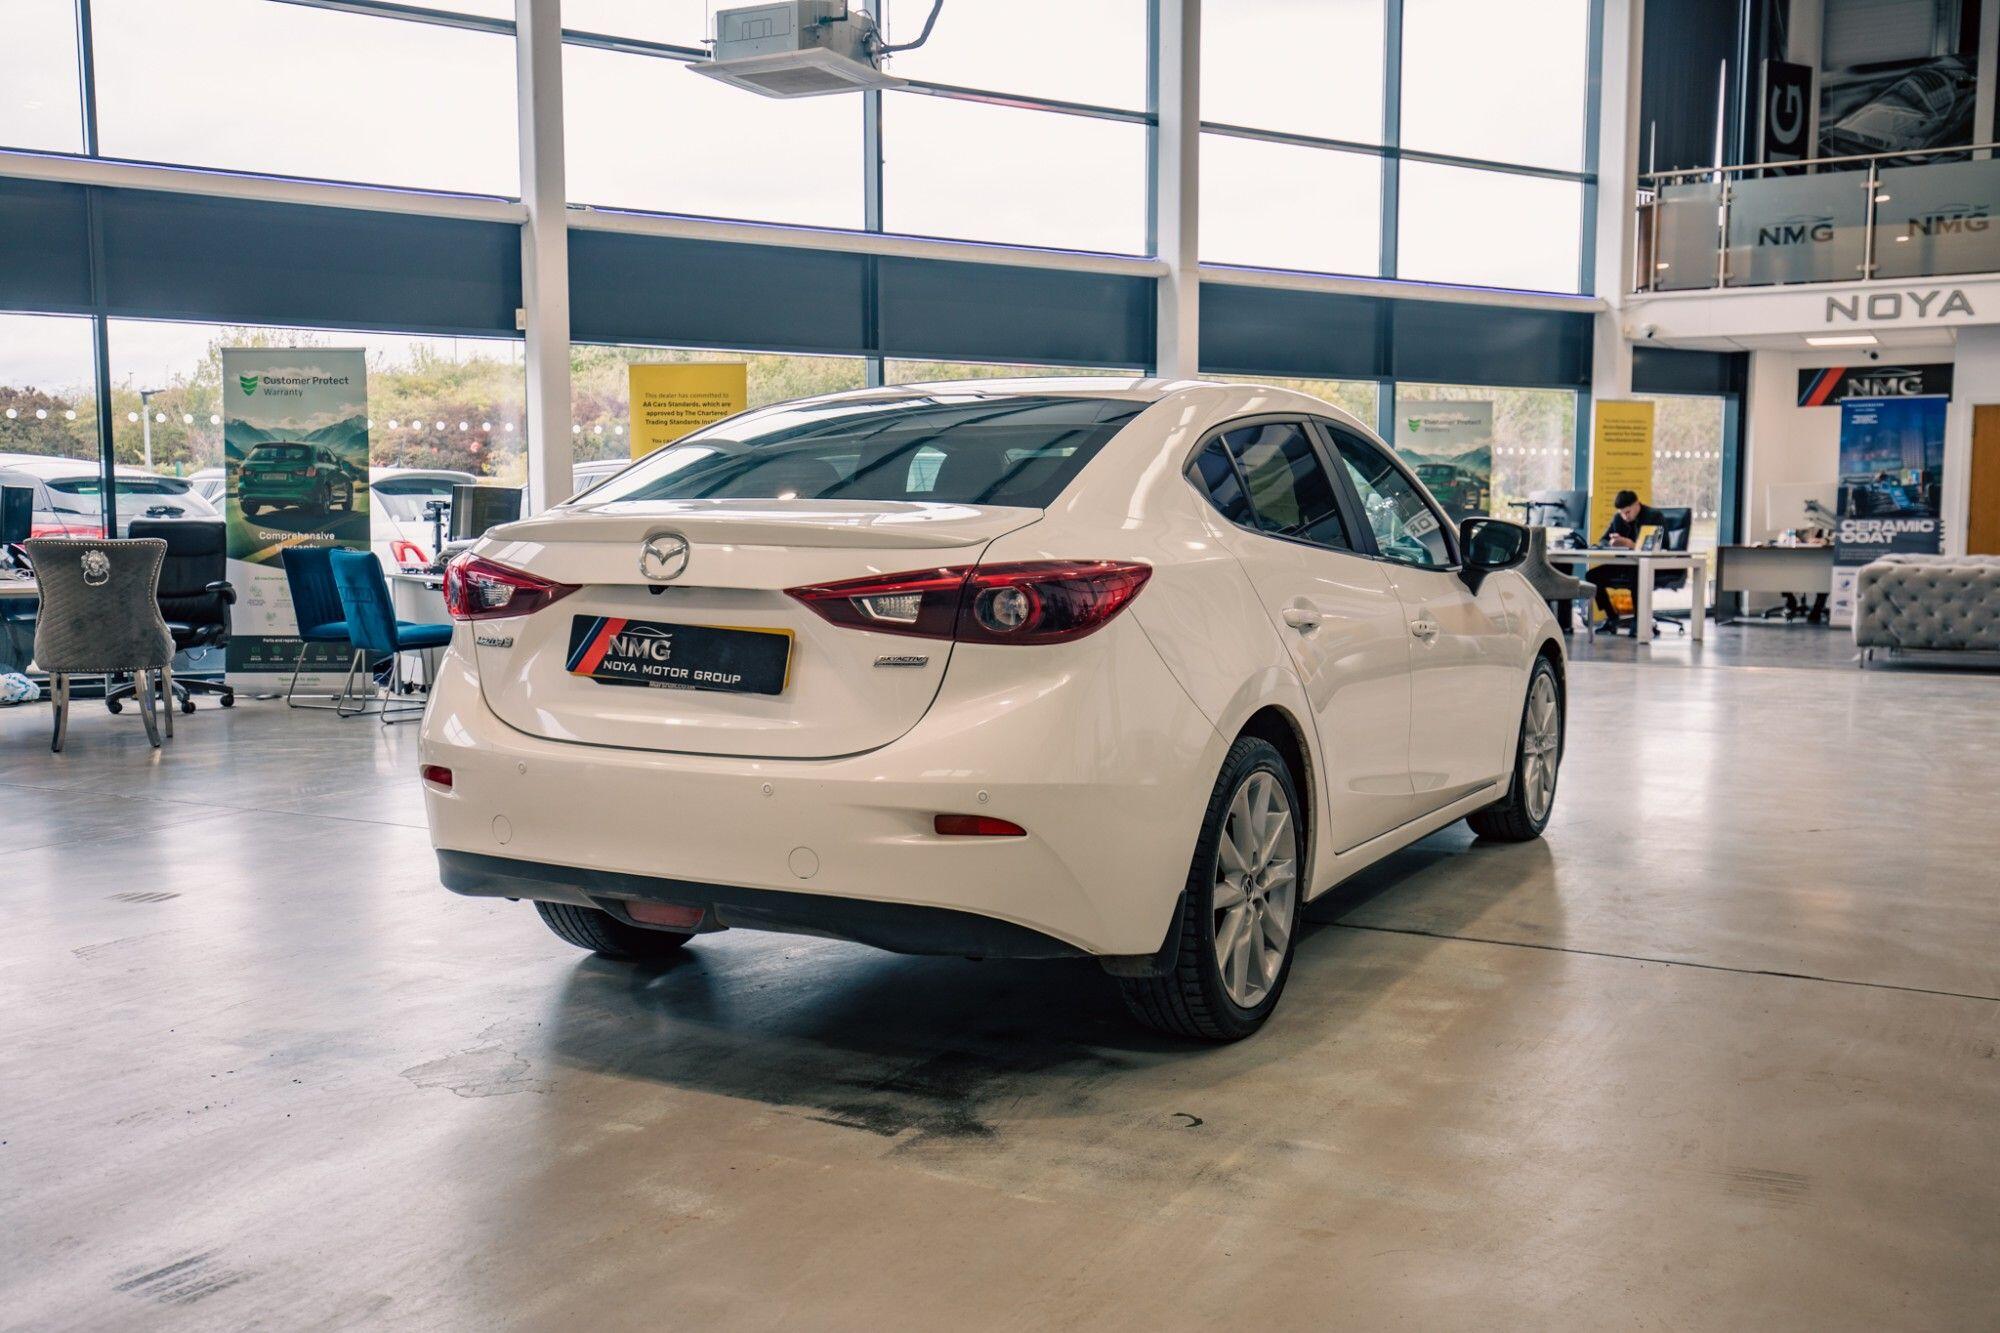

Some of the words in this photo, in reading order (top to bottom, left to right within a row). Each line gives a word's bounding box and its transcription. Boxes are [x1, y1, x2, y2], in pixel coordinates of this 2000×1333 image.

[1758, 223, 1834, 247] NMG
[1907, 212, 1989, 238] NMG
[1825, 289, 1975, 323] NOYA
[263, 376, 309, 385] Customer
[312, 376, 349, 385] Protect
[1847, 376, 1923, 397] NMG
[263, 388, 303, 397] Warranty
[259, 531, 335, 541] Comprehensive
[1840, 519, 1935, 533] CERAMIC
[1840, 532, 1897, 544] COAT
[607, 634, 672, 661] NMG
[603, 660, 637, 673] NOYA
[642, 664, 689, 678] MOTOR
[693, 670, 741, 684] GROUP
